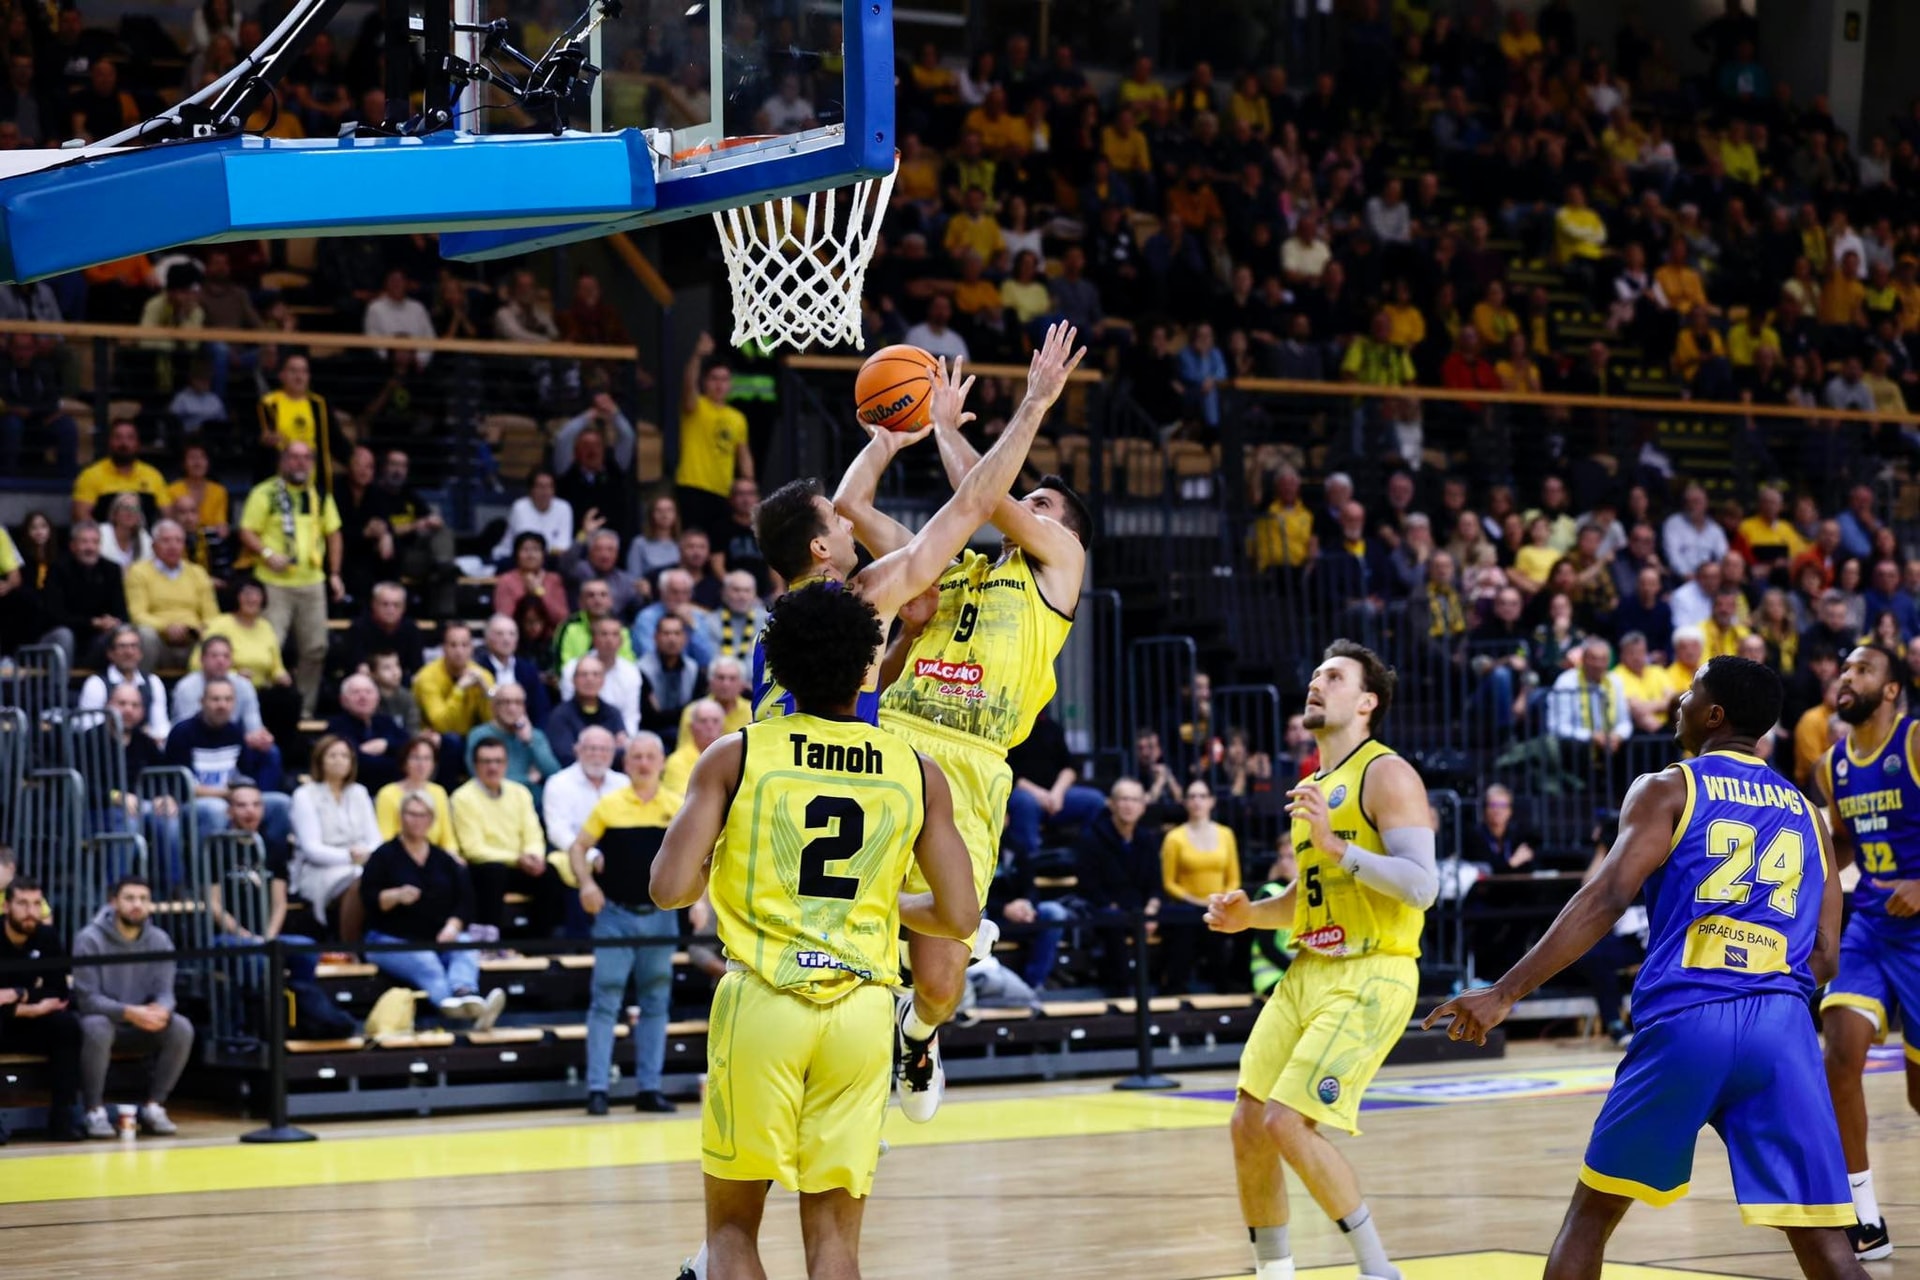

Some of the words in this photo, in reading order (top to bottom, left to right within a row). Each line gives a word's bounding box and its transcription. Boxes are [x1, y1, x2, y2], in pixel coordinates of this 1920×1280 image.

[863, 394, 915, 424] Wilson
[953, 603, 978, 642] 9
[790, 733, 883, 774] Tanoh
[1702, 775, 1803, 815] WILLIAMS
[798, 795, 865, 900] 2
[1861, 842, 1897, 873] 32
[1306, 865, 1323, 908] 5
[1694, 818, 1805, 919] 24
[1698, 923, 1745, 942] PIRAEUS
[1747, 932, 1778, 951] BANK
